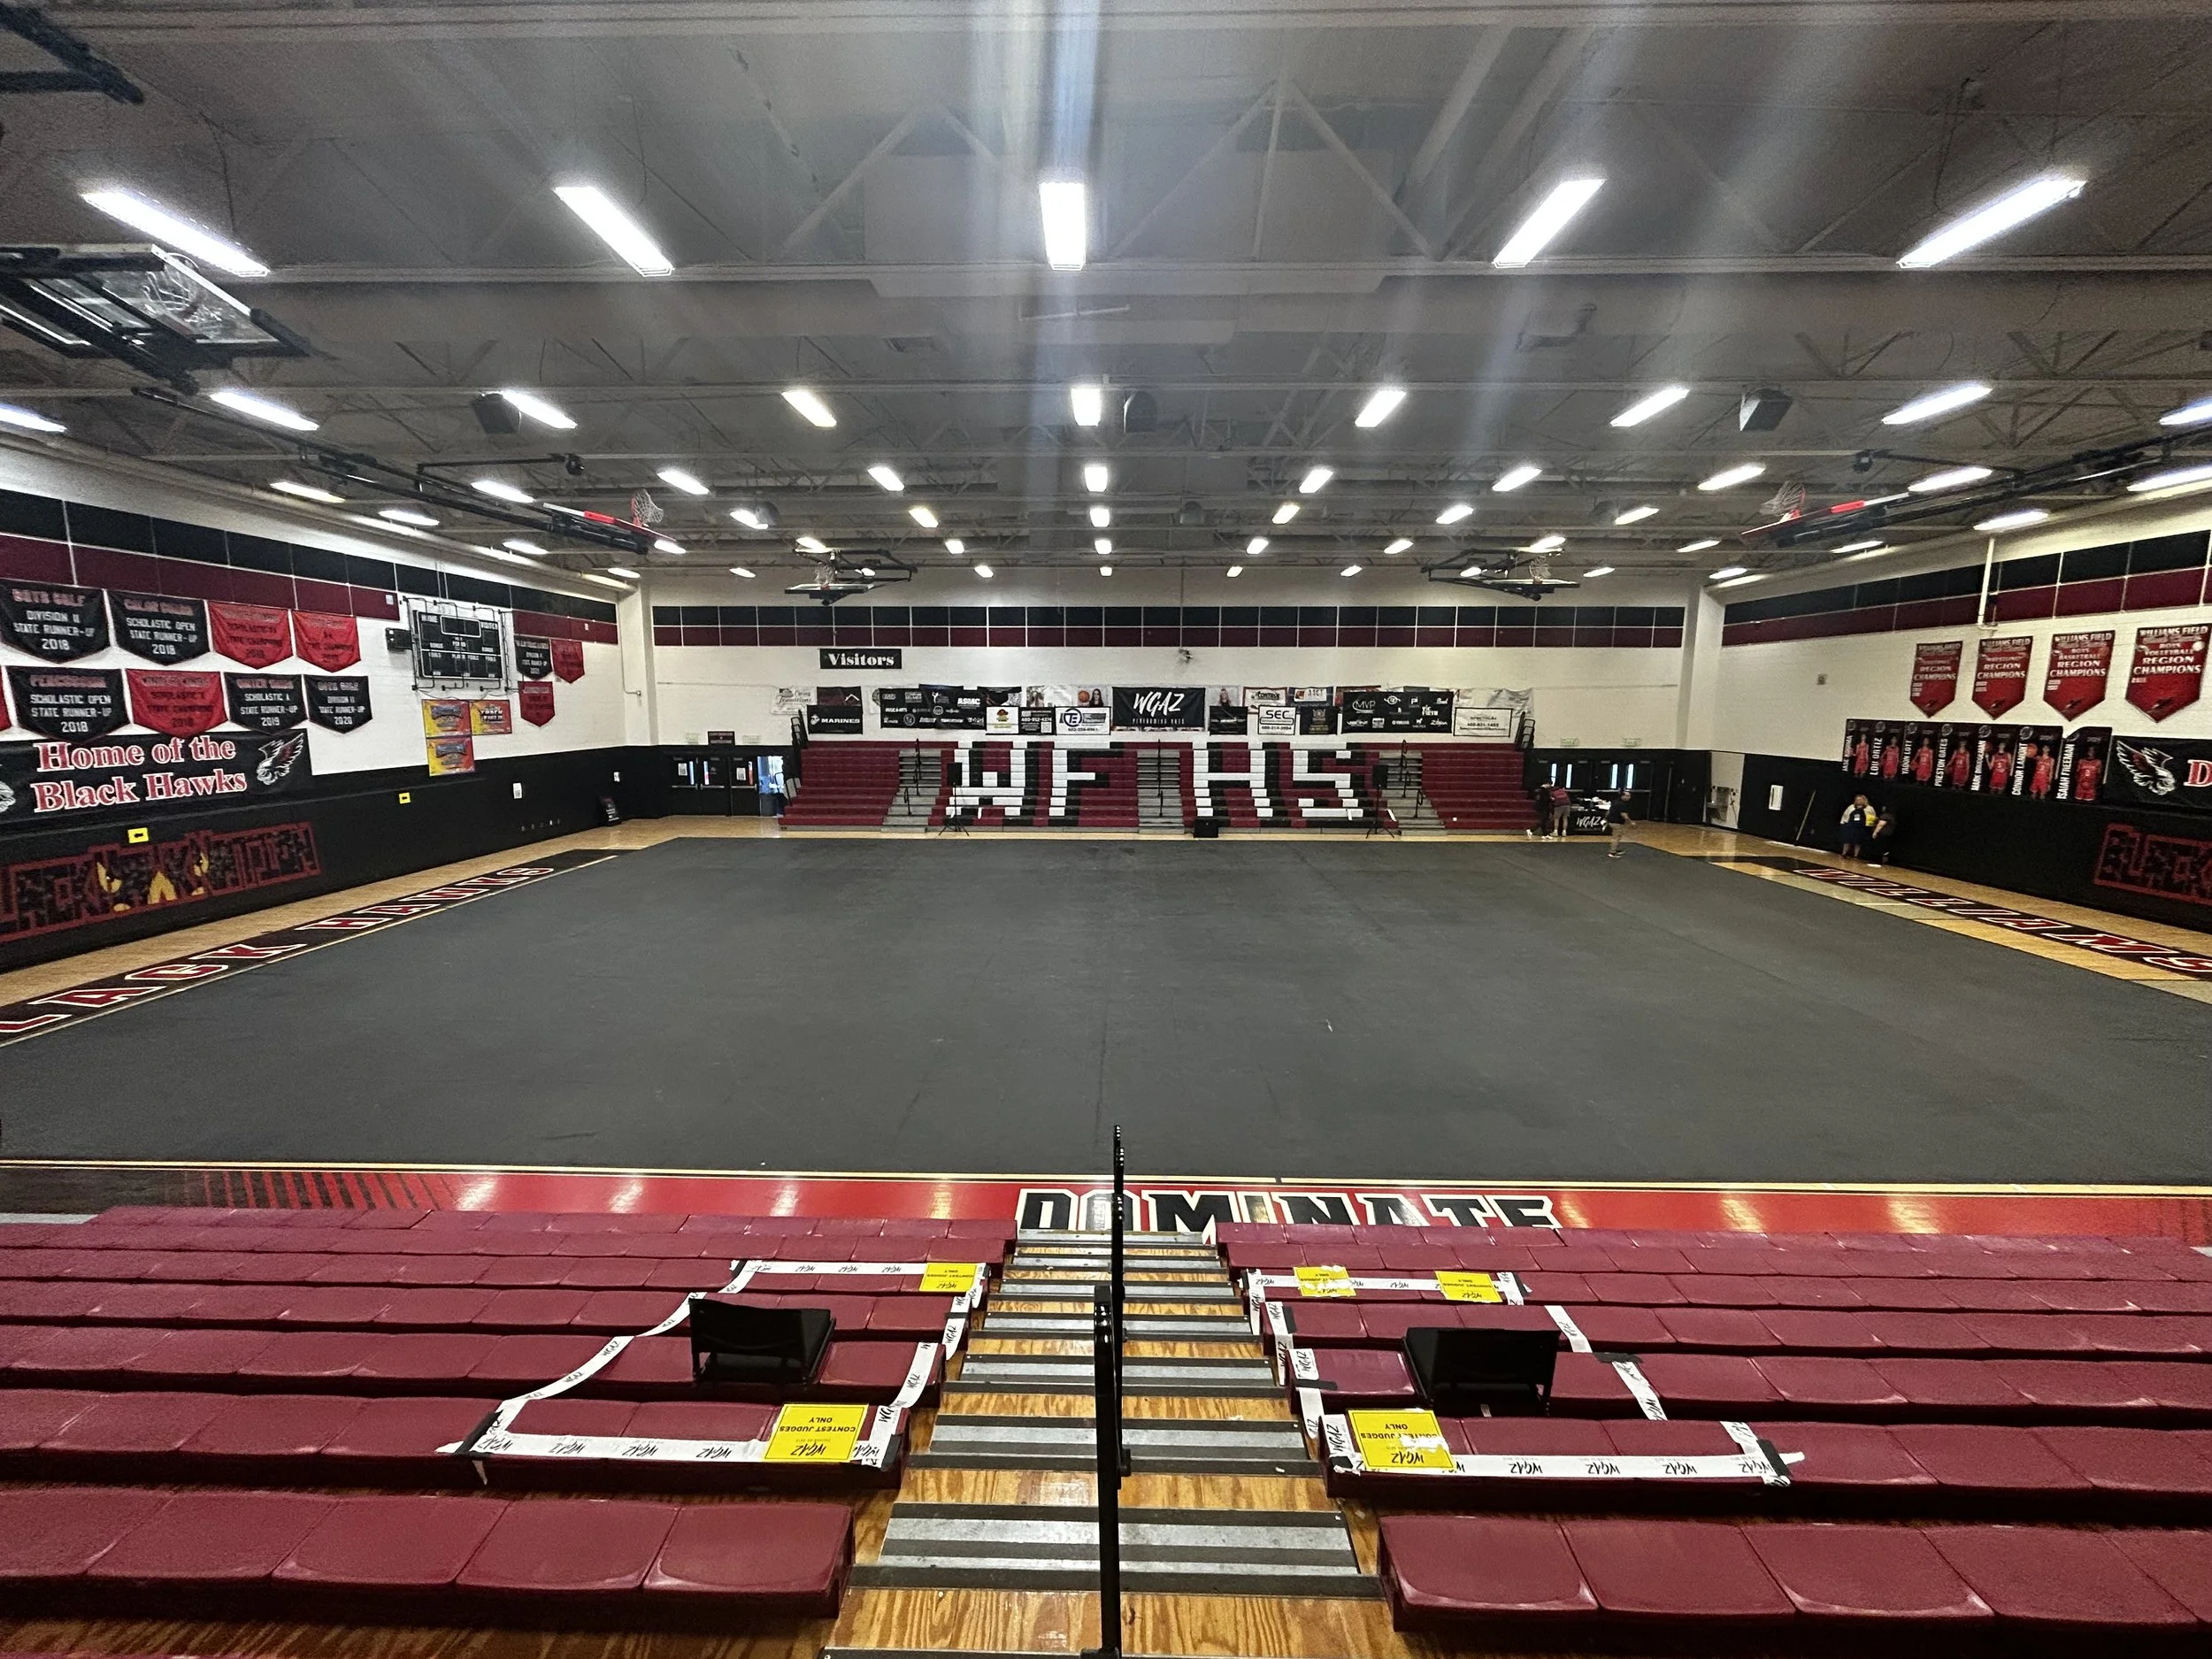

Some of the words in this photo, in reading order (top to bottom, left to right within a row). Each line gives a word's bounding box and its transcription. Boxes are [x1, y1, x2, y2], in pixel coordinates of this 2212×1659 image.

[27, 611, 68, 622] DIVISION
[13, 622, 40, 634] STATE
[43, 625, 95, 637] RUNNER-UP
[126, 618, 172, 629] SCHOLASTIC
[175, 621, 196, 631] OPEN
[129, 630, 151, 640] STATE
[154, 632, 197, 642] RUNNER-UP
[2139, 627, 2180, 637] WILLIAMS
[2182, 626, 2208, 634] FIELD
[41, 638, 70, 650] 2018
[151, 644, 176, 655] 2018
[827, 652, 895, 665] Visitors
[2142, 656, 2194, 664] REGION
[2049, 668, 2106, 677] CHAMPIONS
[2133, 664, 2201, 674] CHAMPIONS
[30, 695, 84, 704] SCHOLASTIC
[88, 695, 111, 704] OPEN
[1133, 691, 1185, 718] WGAZ
[31, 708, 59, 718] STATE
[62, 708, 112, 718] RUNNER-UP
[241, 706, 258, 715] STATE
[261, 705, 297, 715] RUNNER-UP
[1265, 710, 1290, 718] SEC
[261, 717, 280, 726] 2019
[334, 716, 353, 725] 2020
[60, 721, 88, 733] 2018
[33, 741, 144, 772] Home
[151, 736, 186, 764] of
[188, 735, 236, 761] the
[1872, 737, 1883, 759] ORTIZ
[2016, 743, 2028, 769] LAMONT
[2062, 744, 2076, 775] FREEMAN
[1869, 761, 1879, 776] LOU
[1934, 757, 1946, 787] PRESTON
[2011, 769, 2024, 795] CONNOR
[2056, 775, 2070, 800] ISAIAH
[30, 777, 142, 813] Black
[142, 769, 248, 802] Hawks
[1577, 816, 1601, 828] WGAZ
[296, 866, 555, 931] HAWKS
[1016, 1188, 1563, 1241] DOMINATE
[1327, 1424, 1345, 1452] WGAZ
[621, 1446, 659, 1458] WGAZ
[695, 1448, 733, 1459] WGAZ
[790, 1443, 826, 1457] WGAZ
[1390, 1452, 1425, 1465] WGAZ
[1509, 1463, 1543, 1474] WGAZ
[1586, 1463, 1621, 1475] WGAZ
[1663, 1463, 1697, 1475] WGAZ
